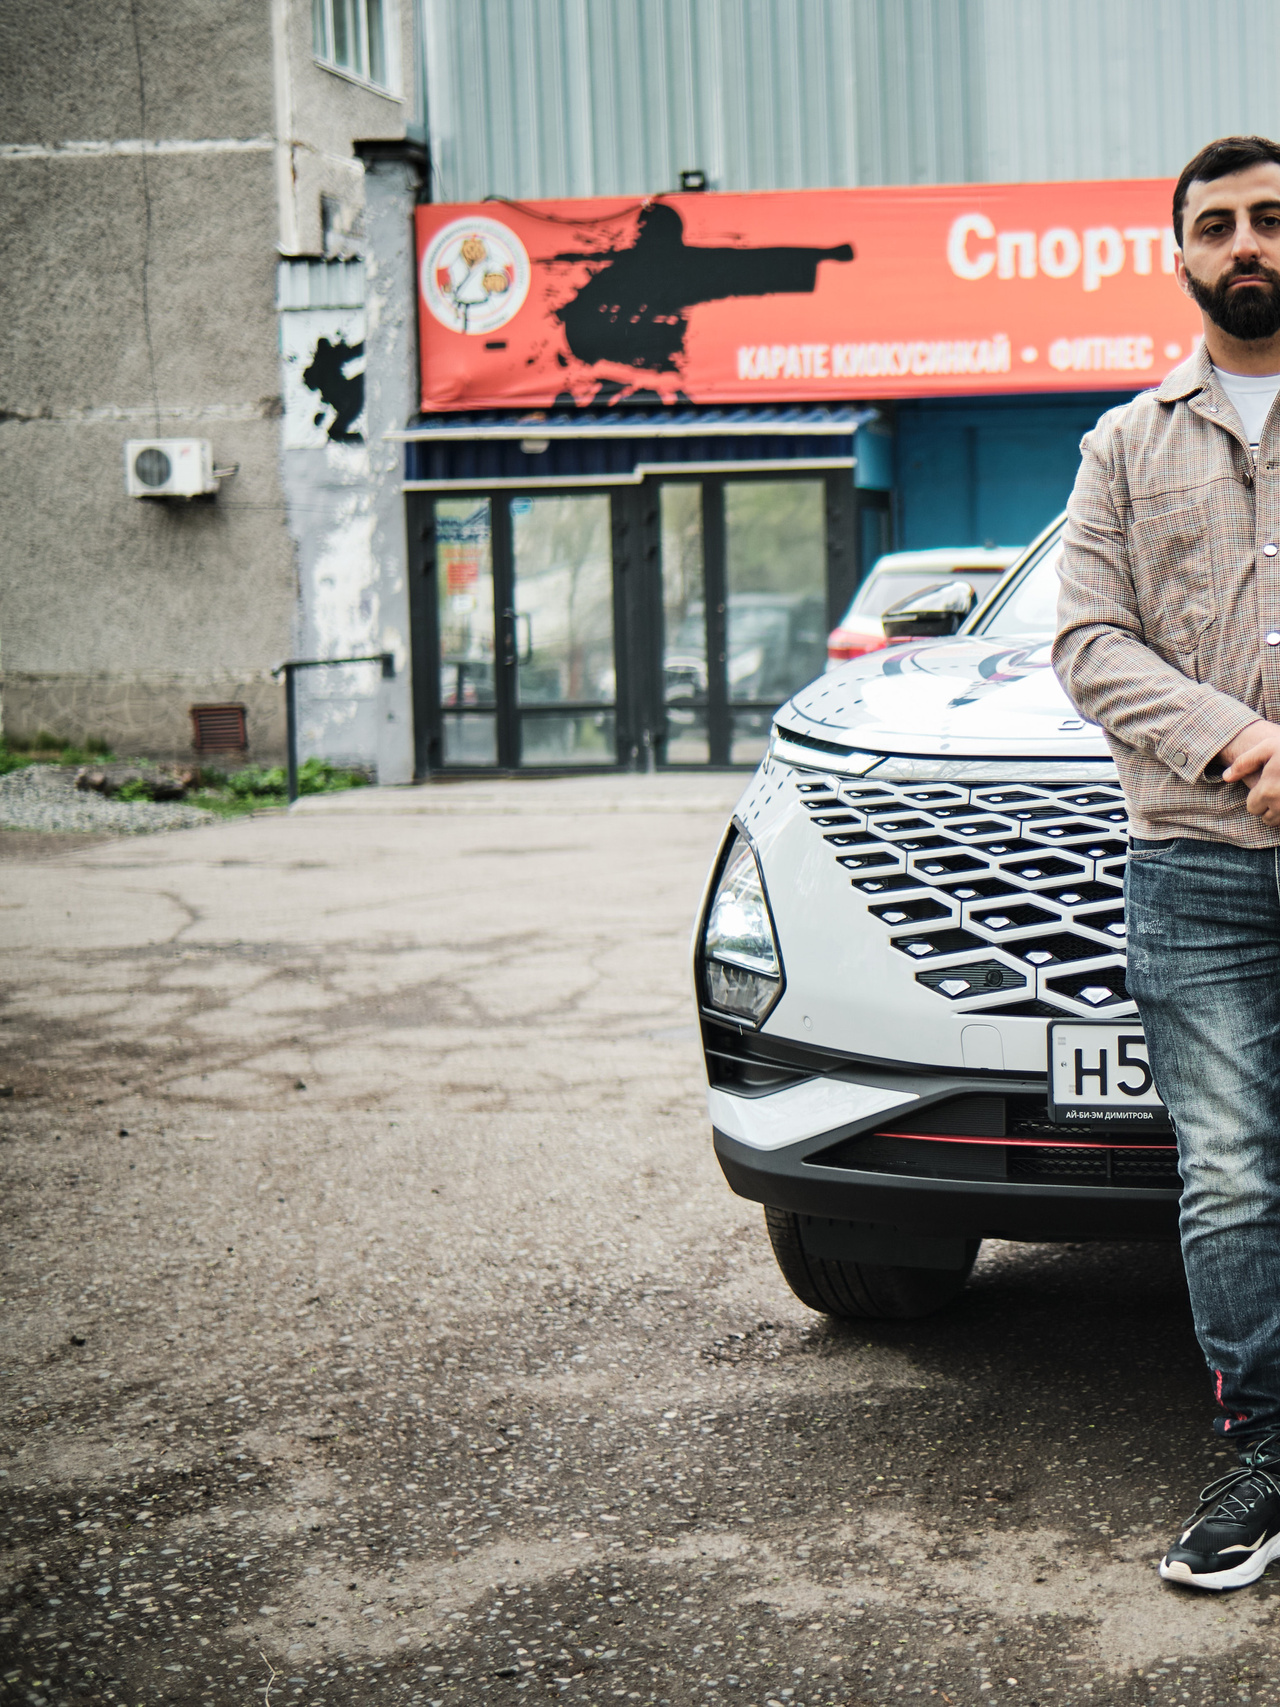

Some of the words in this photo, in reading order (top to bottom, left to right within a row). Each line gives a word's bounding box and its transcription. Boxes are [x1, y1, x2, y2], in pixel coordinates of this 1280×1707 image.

[738, 343, 829, 379] КАРАТЕ
[833, 335, 1010, 376] КИОКУСИНКАЙ
[1048, 336, 1154, 371] ФИТНЕС
[1066, 1110, 1103, 1119] АЙ-БИ-ЭМ
[1104, 1111, 1153, 1120] ДИМИТРОВА
